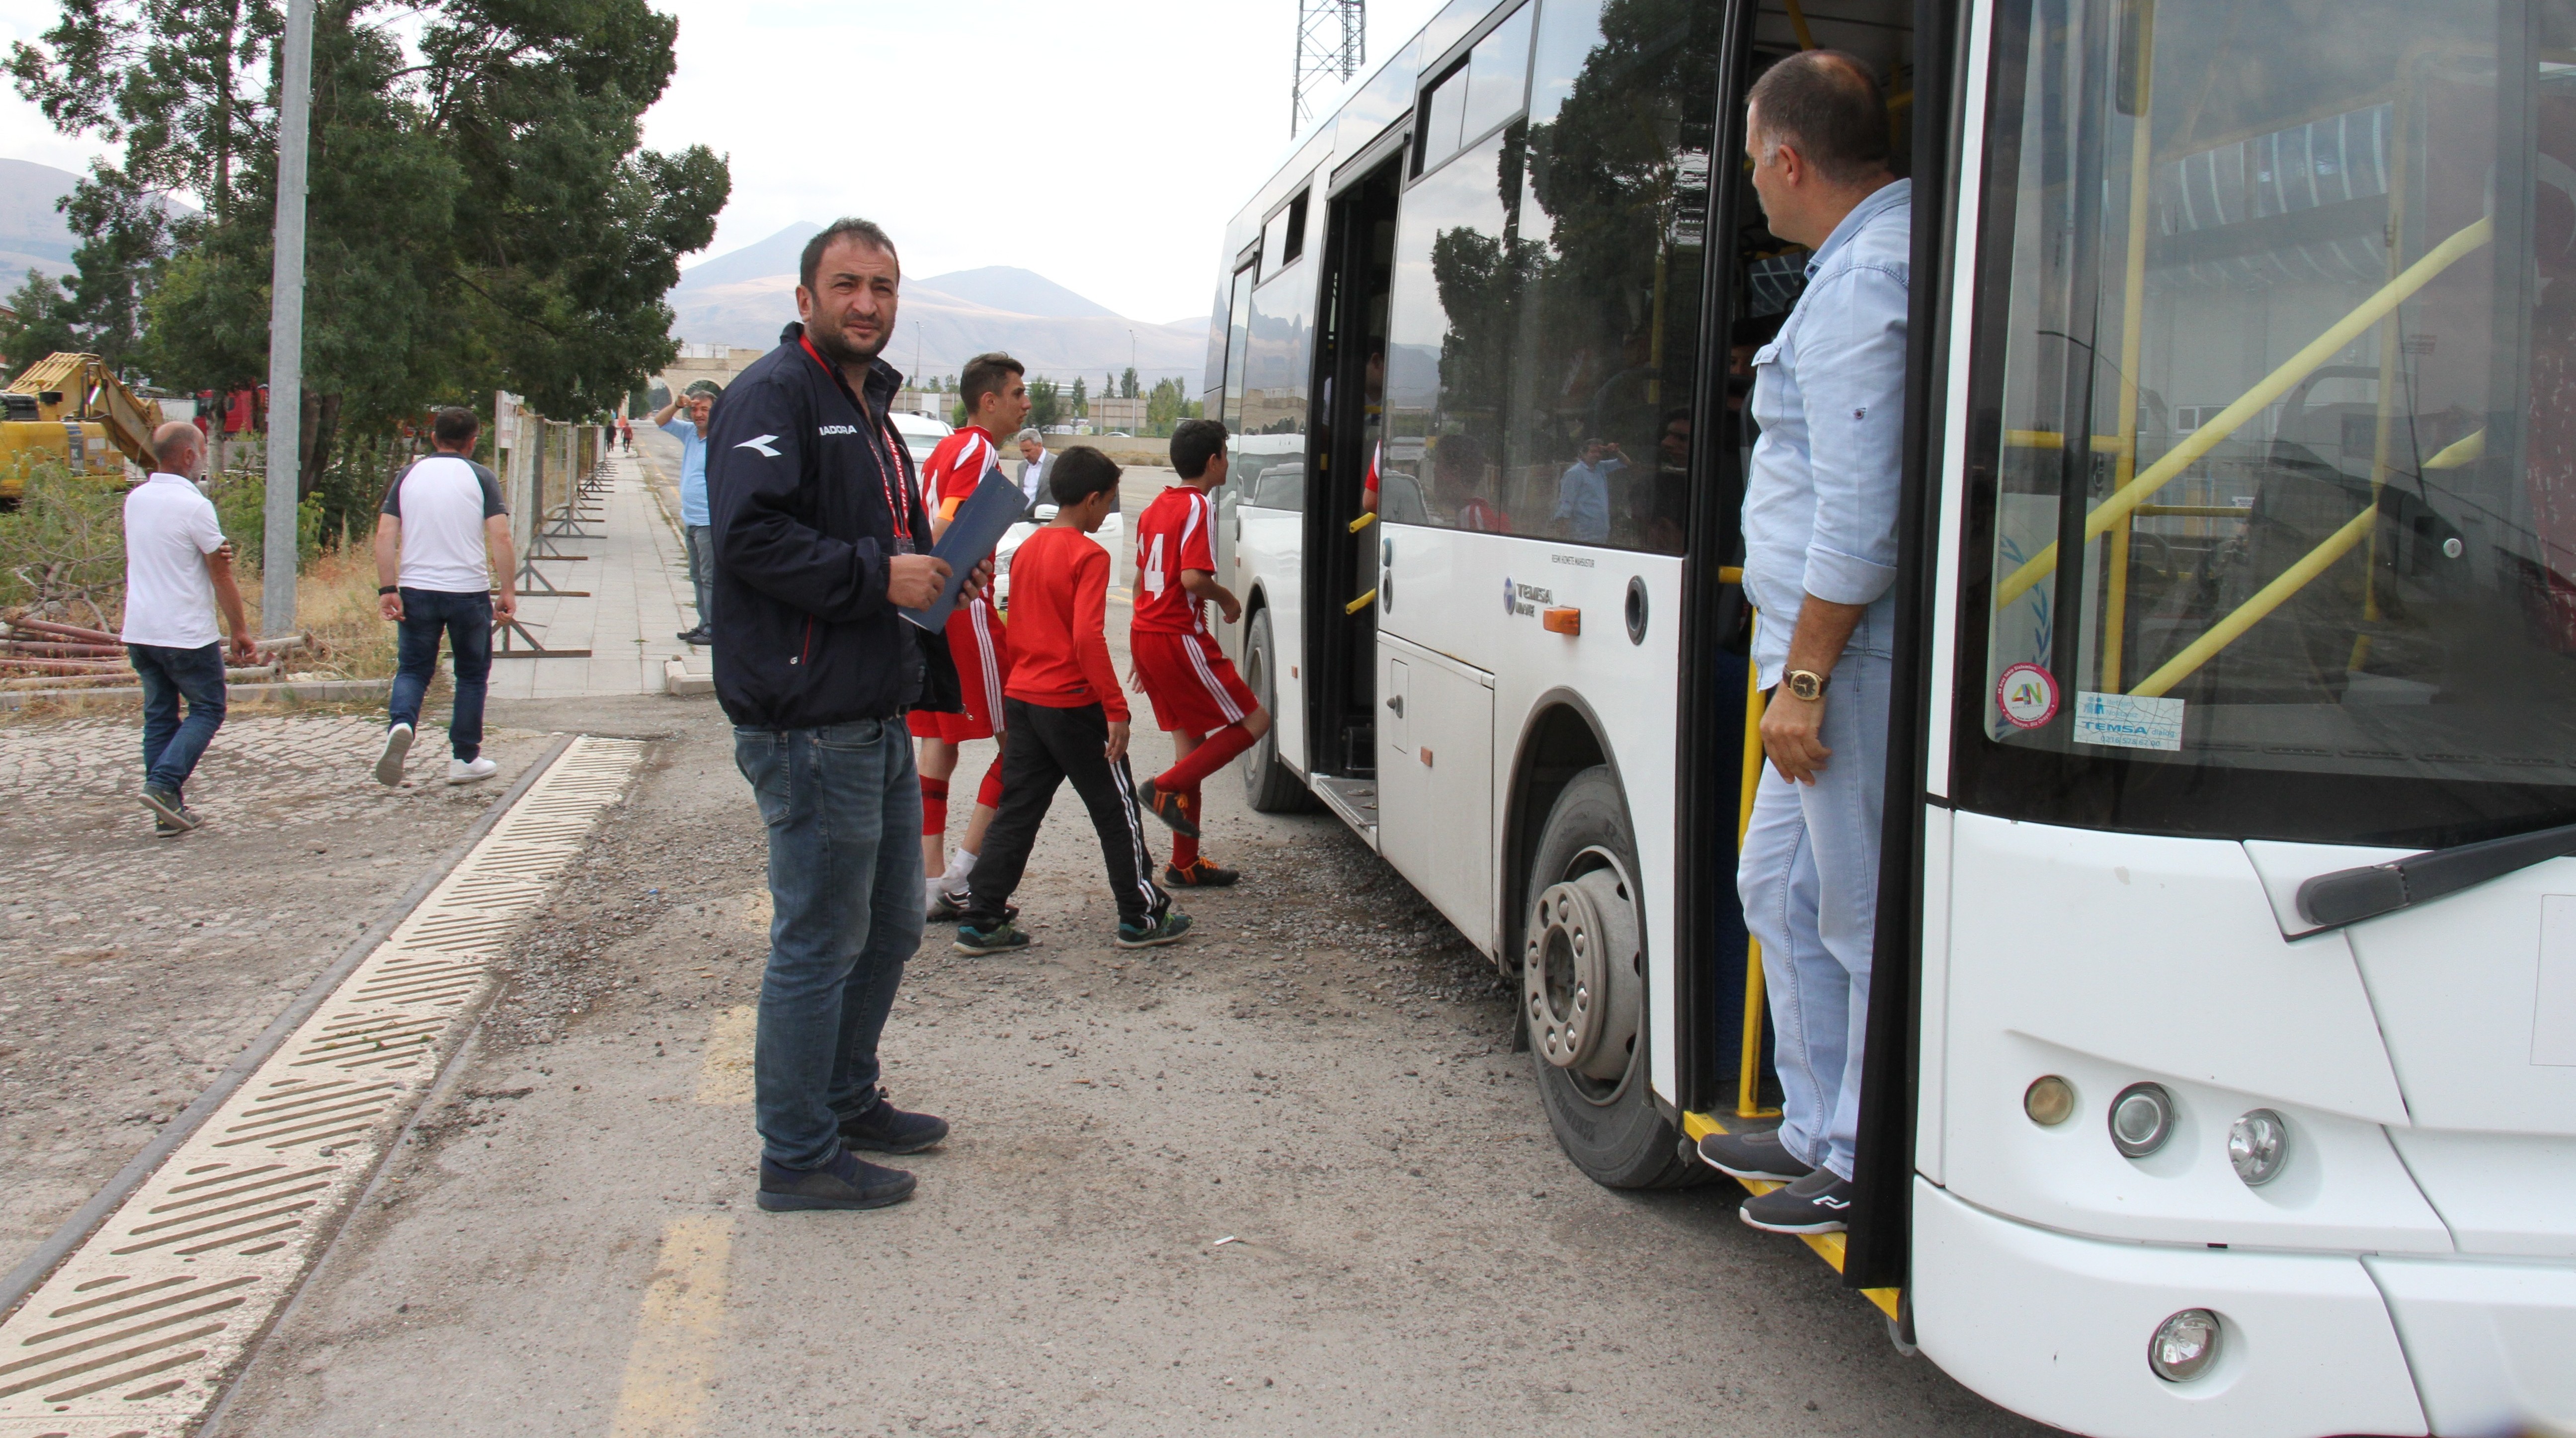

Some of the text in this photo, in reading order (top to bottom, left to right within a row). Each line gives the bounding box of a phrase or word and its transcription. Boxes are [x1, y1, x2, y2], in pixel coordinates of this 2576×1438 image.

[819, 425, 858, 436] IADORA
[1516, 583, 1553, 605] TEMSA
[2011, 681, 2043, 705] 4N
[2082, 721, 2175, 738] TEMSA dialog
